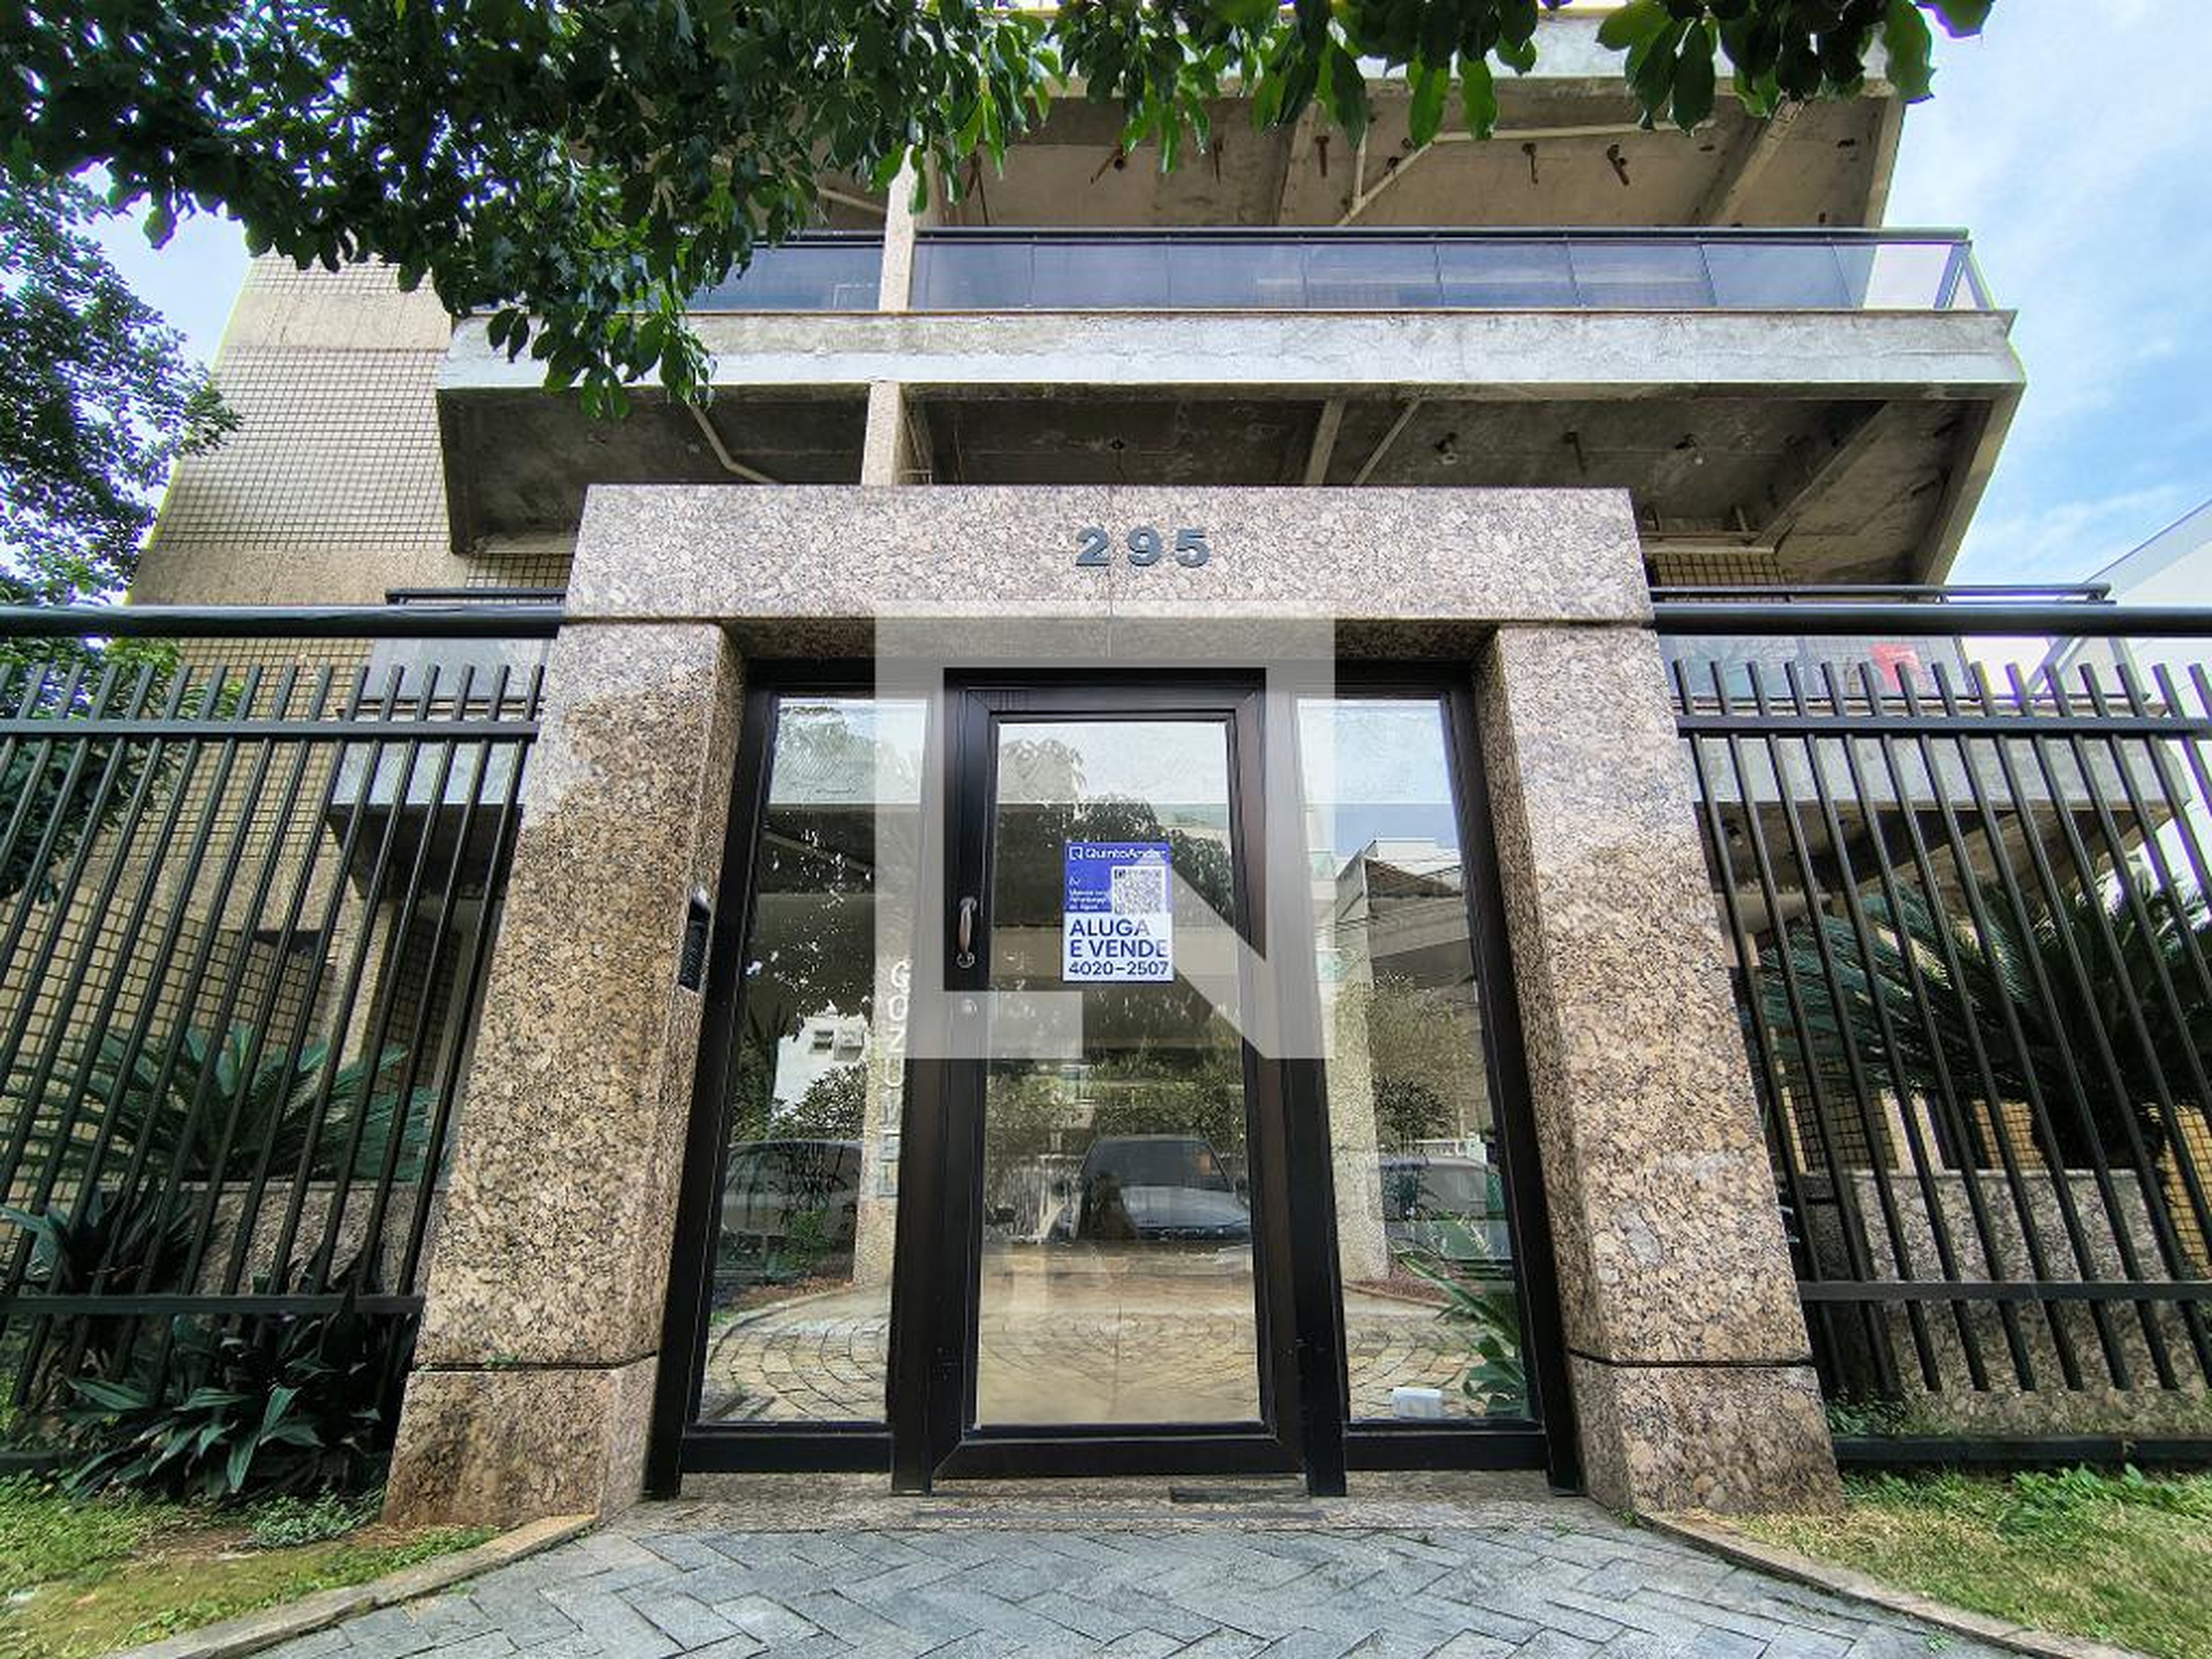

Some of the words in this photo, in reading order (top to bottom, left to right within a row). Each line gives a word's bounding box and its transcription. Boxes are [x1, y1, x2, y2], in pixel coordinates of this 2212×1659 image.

[1075, 526, 1210, 567] 295
[1069, 919, 1150, 937] ALUGA
[1070, 939, 1083, 957] E
[1088, 939, 1169, 957] VENDE
[1069, 960, 1169, 975] 4020-2507
